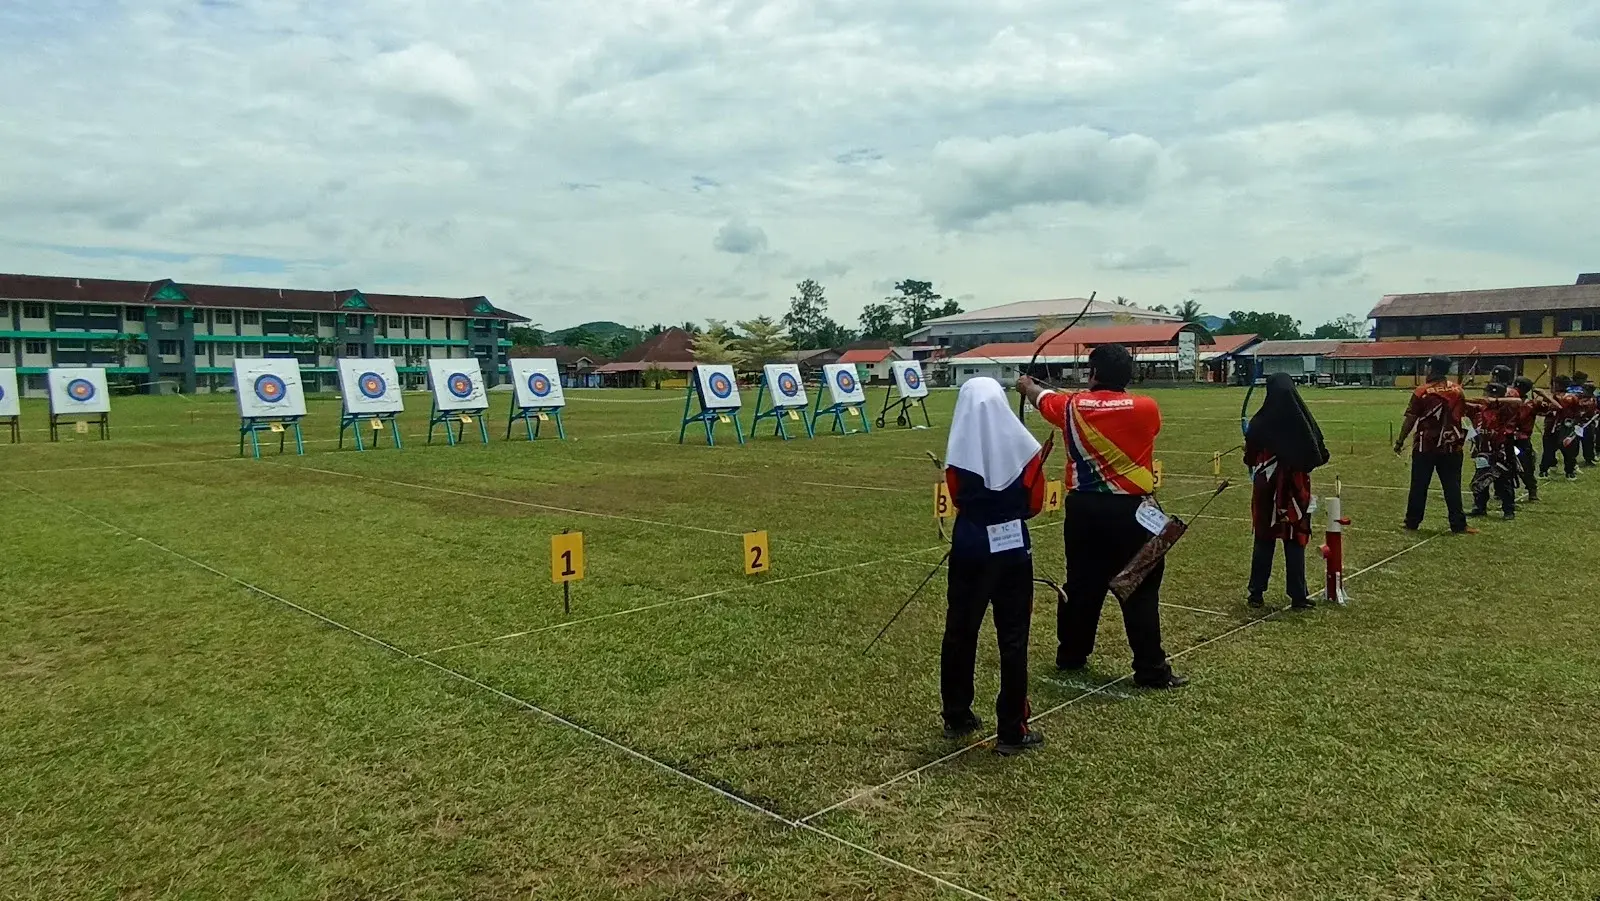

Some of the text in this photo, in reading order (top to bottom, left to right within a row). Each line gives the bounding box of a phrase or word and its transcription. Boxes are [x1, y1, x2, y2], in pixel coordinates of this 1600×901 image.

[1102, 398, 1134, 407] NAKA
[1153, 470, 1159, 485] 5
[938, 494, 947, 513] 3
[1049, 490, 1058, 507] 4
[561, 549, 576, 577] 1
[750, 545, 763, 569] 2
